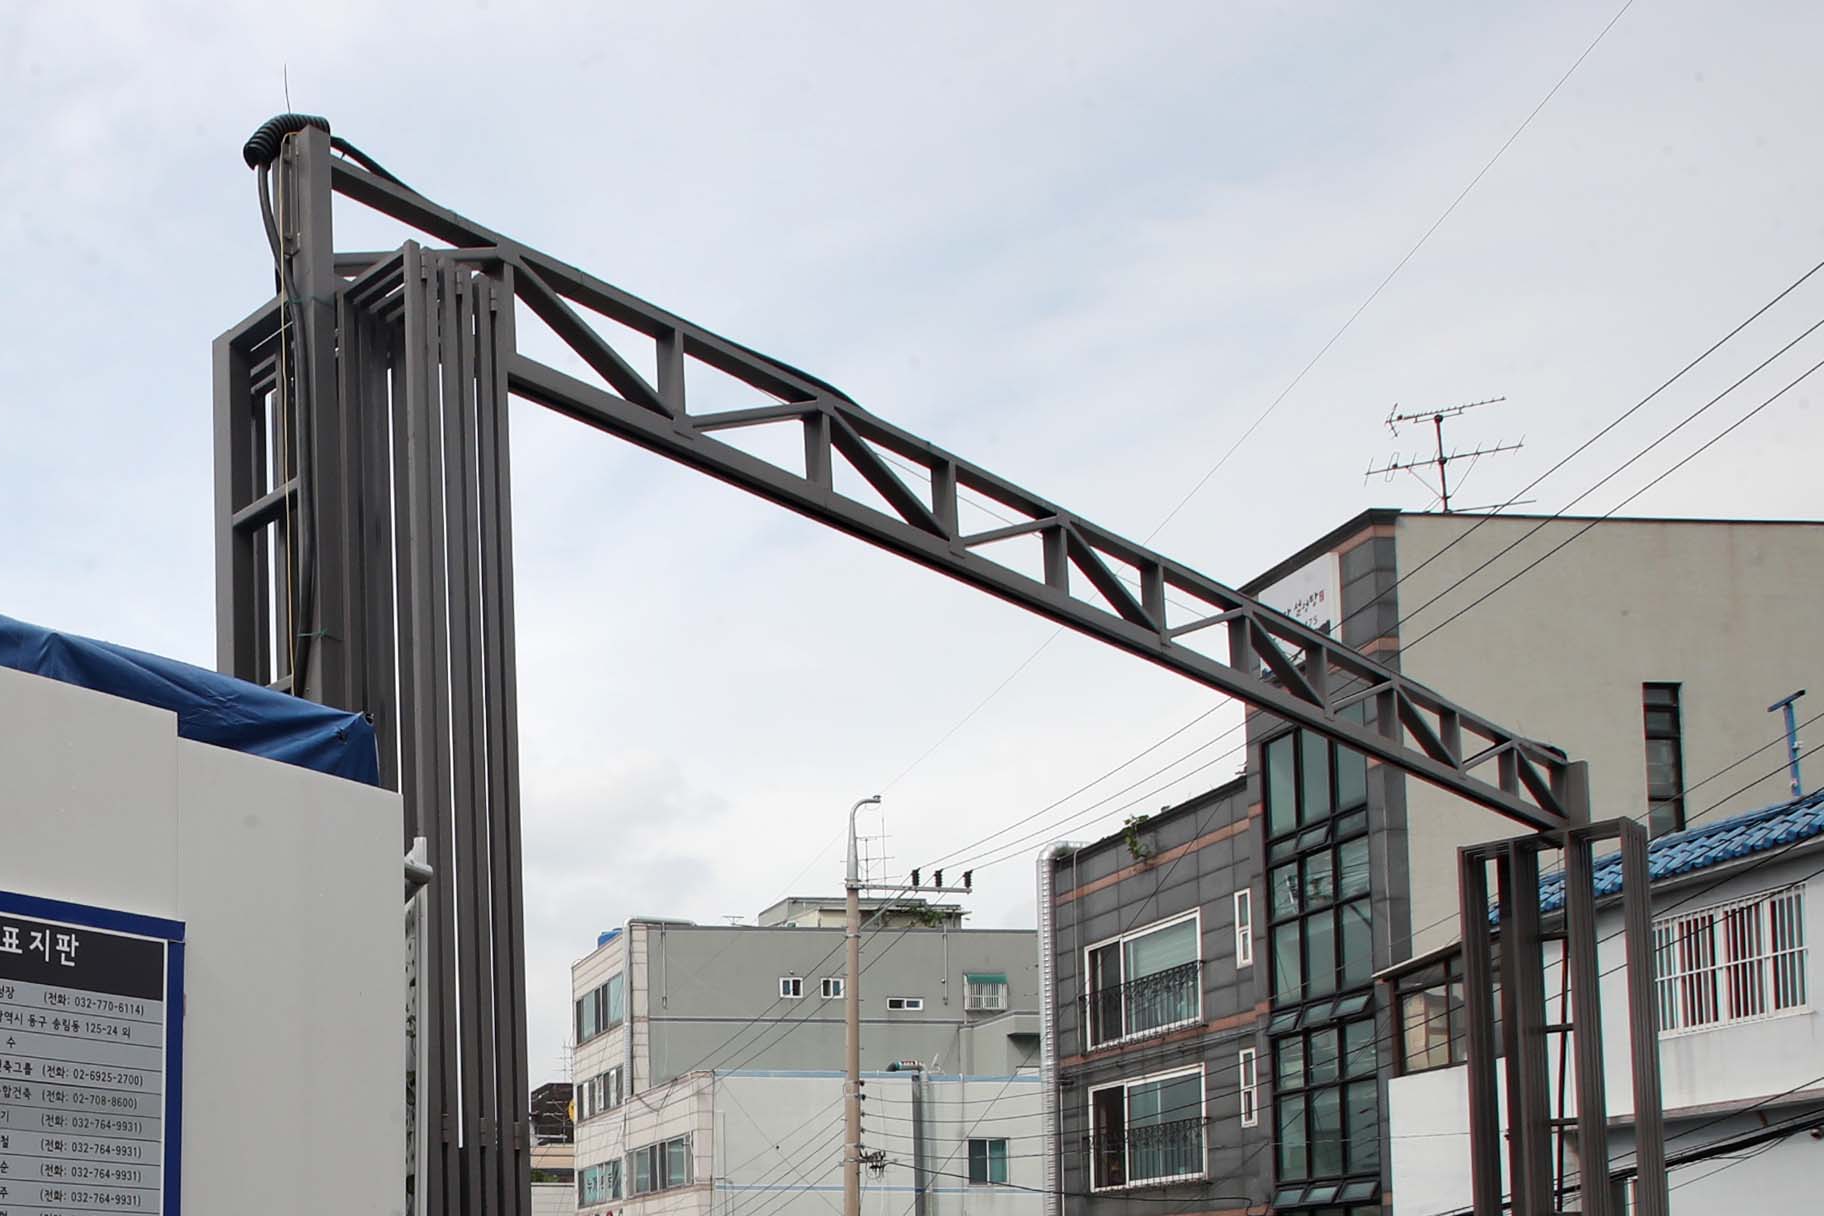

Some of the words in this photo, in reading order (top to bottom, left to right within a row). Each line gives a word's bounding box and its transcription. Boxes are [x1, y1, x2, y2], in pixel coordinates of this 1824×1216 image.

[75, 996, 144, 1016] 032-770-6114)
[28, 1016, 47, 1028] 동구
[52, 1018, 80, 1033] 송림동
[85, 1022, 118, 1036] 125-24
[73, 1069, 143, 1087] 02-6925-2700)
[73, 1093, 137, 1110] 02-708-8600)
[72, 1117, 142, 1134] 032-764-9931)
